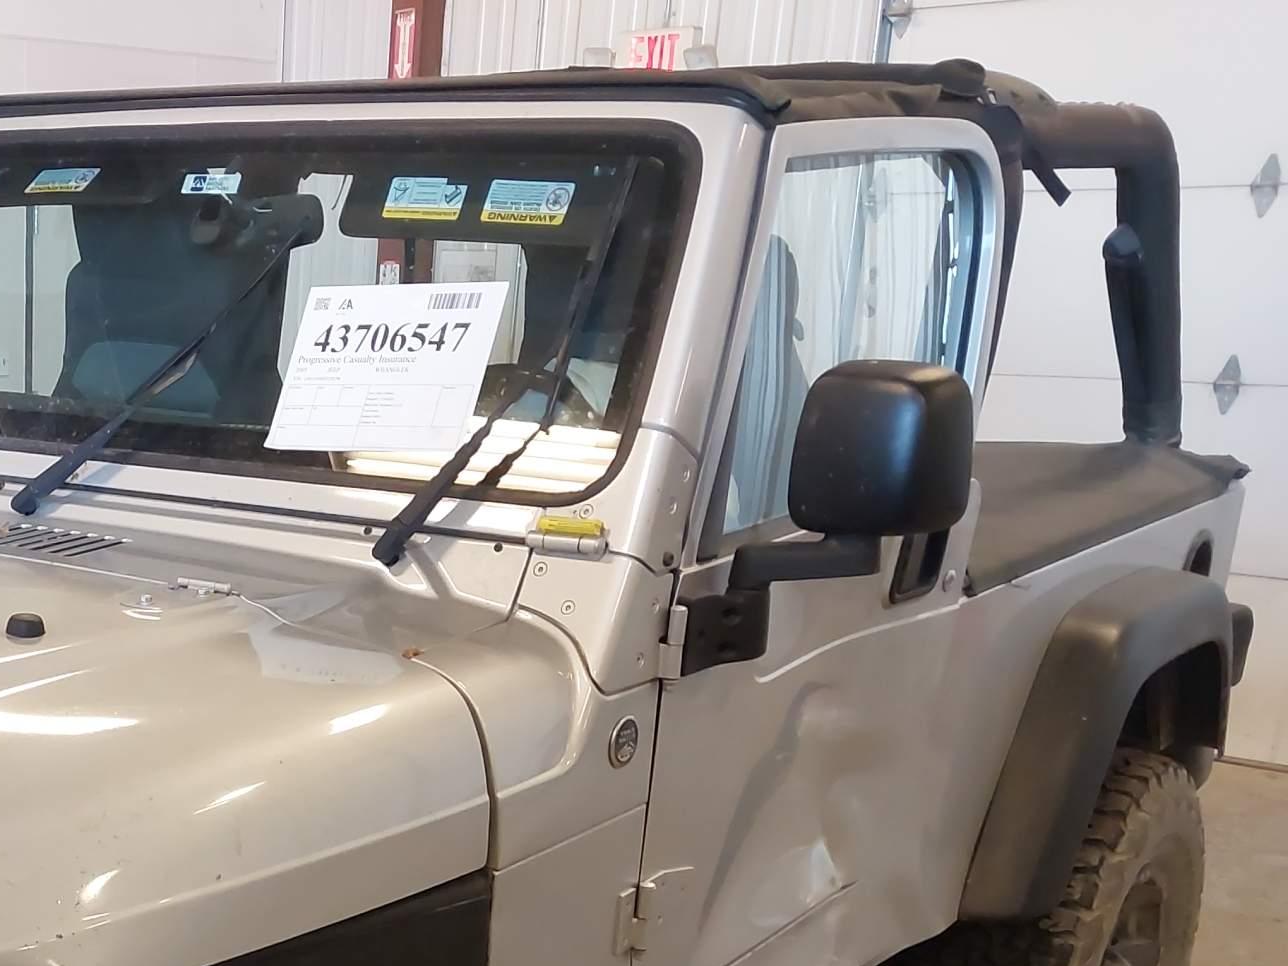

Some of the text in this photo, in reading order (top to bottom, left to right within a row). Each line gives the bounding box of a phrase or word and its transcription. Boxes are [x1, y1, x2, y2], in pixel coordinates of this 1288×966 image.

[630, 33, 681, 72] EXIT
[487, 211, 547, 223] WARNING
[314, 322, 472, 353] 43706547
[298, 354, 417, 365] Progressive Casualty Insurance
